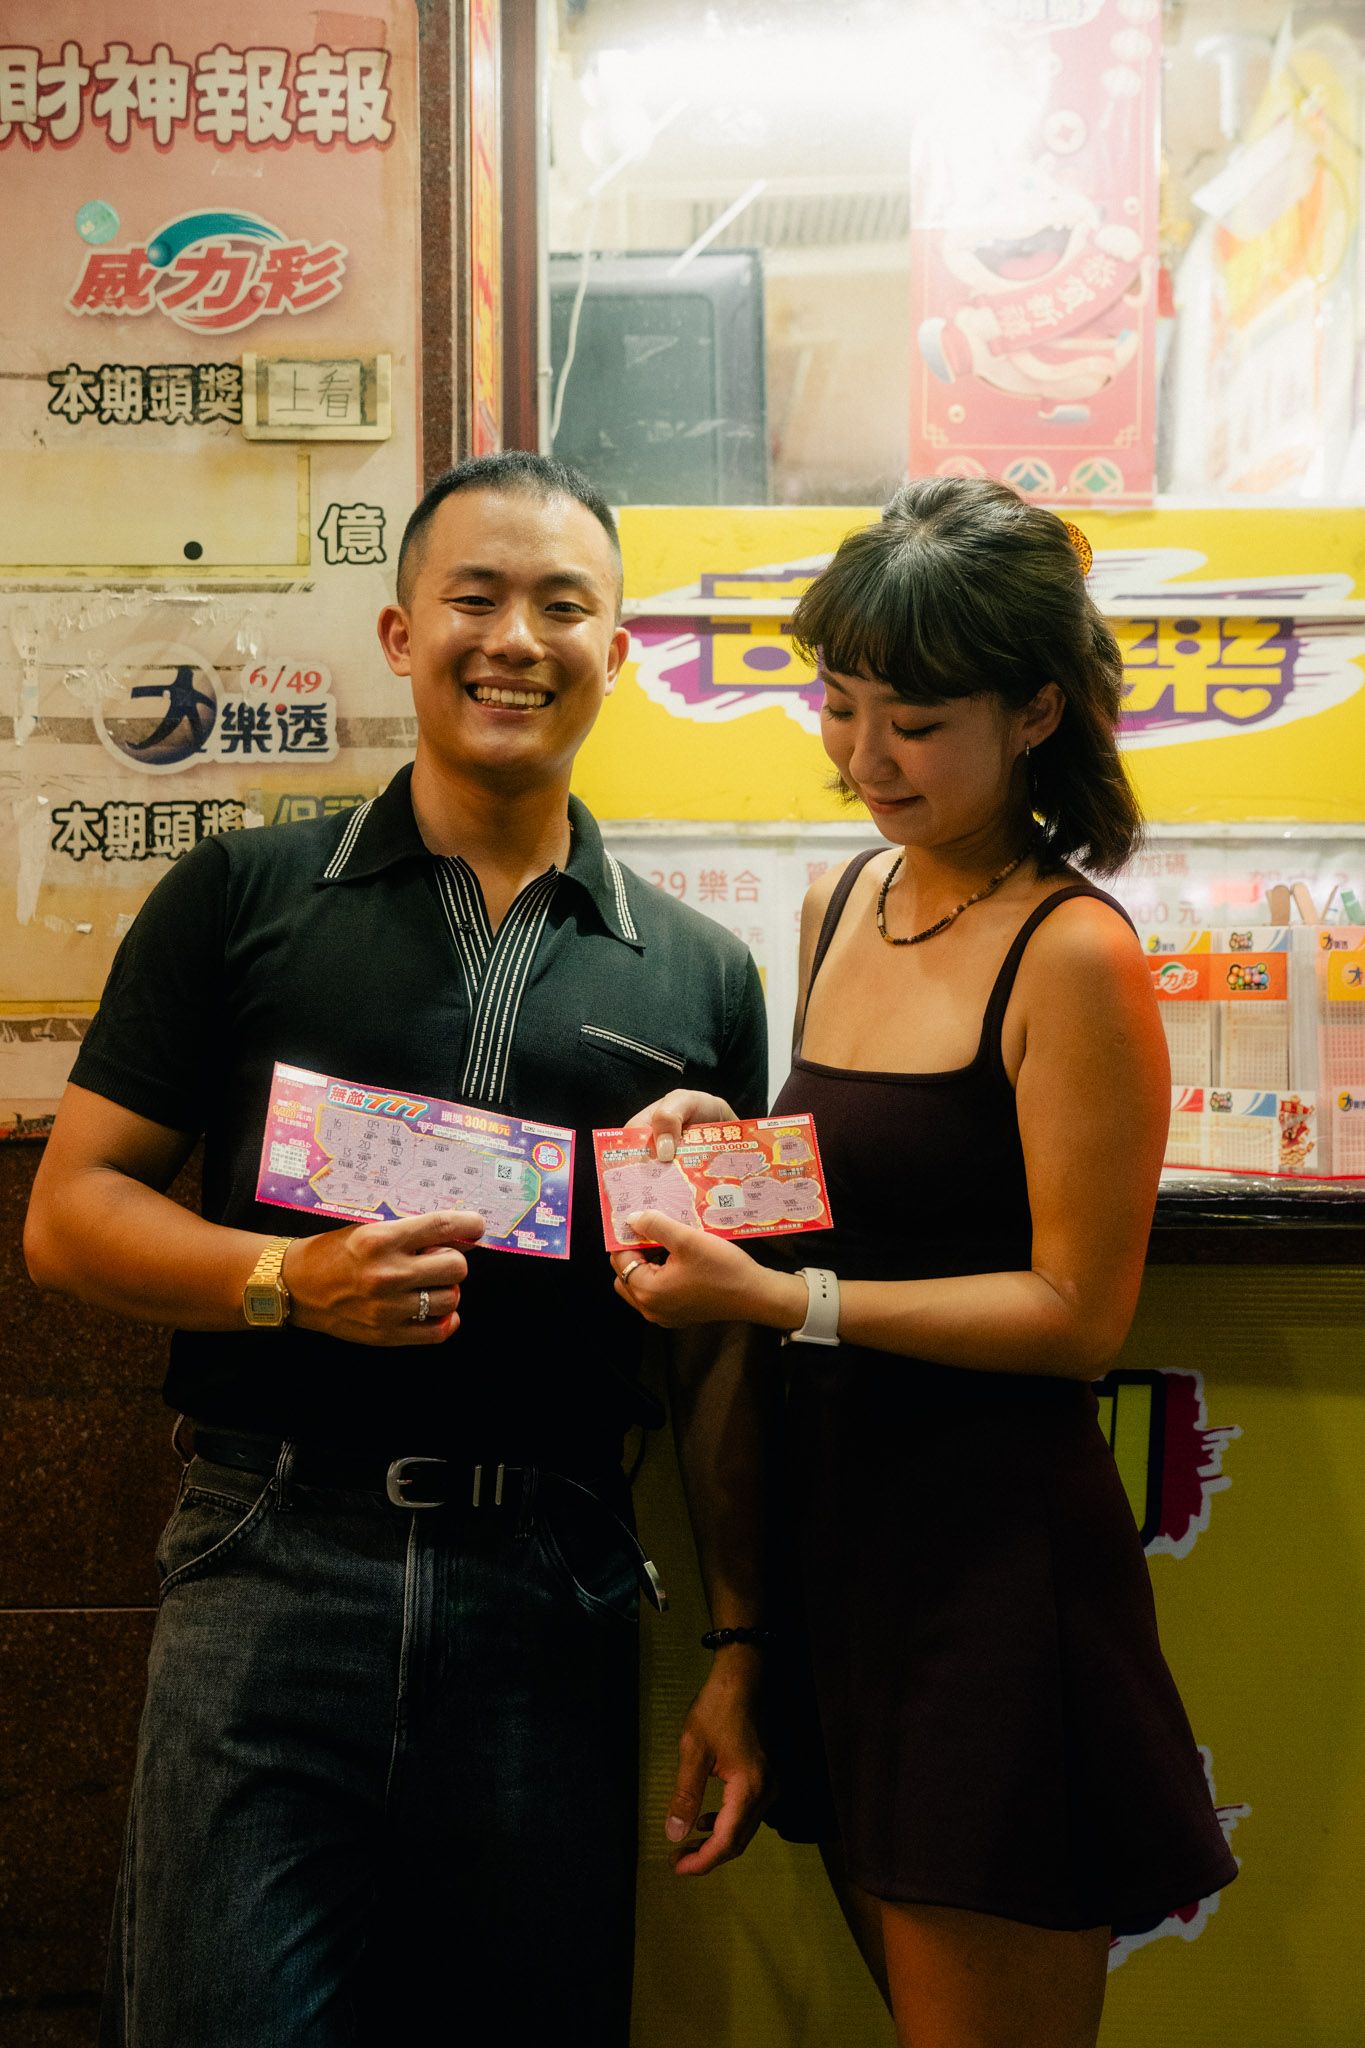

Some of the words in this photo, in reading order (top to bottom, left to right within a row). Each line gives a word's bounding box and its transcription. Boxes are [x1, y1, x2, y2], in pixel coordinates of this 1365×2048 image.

[0, 41, 396, 149] 財神報報
[67, 240, 347, 317] 威力彩
[48, 363, 243, 426] 本期頭獎
[275, 368, 353, 419] 上看
[317, 502, 387, 565] 億
[249, 665, 323, 695] 6/49
[330, 1086, 427, 1119] 無敵777
